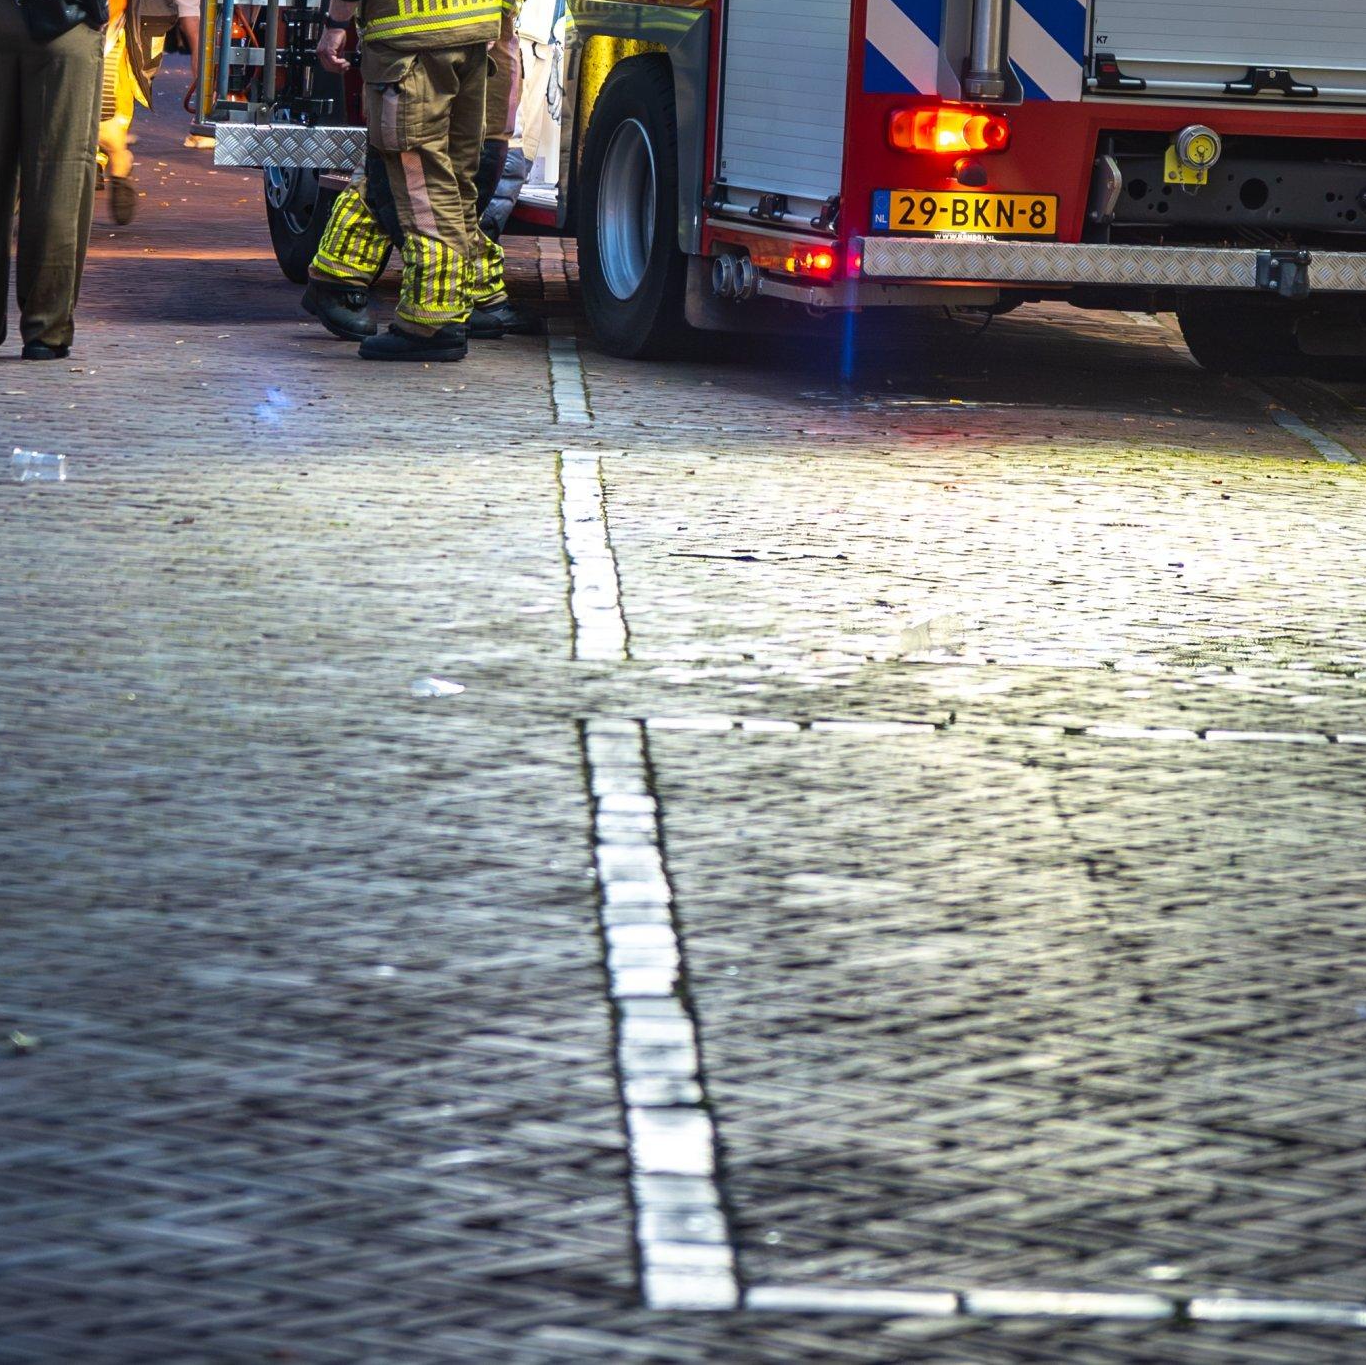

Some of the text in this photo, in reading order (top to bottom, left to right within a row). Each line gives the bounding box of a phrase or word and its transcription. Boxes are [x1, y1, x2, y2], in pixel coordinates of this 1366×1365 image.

[1096, 35, 1108, 44] K7
[898, 196, 1047, 229] 29-BKN-8
[875, 213, 888, 224] NL
